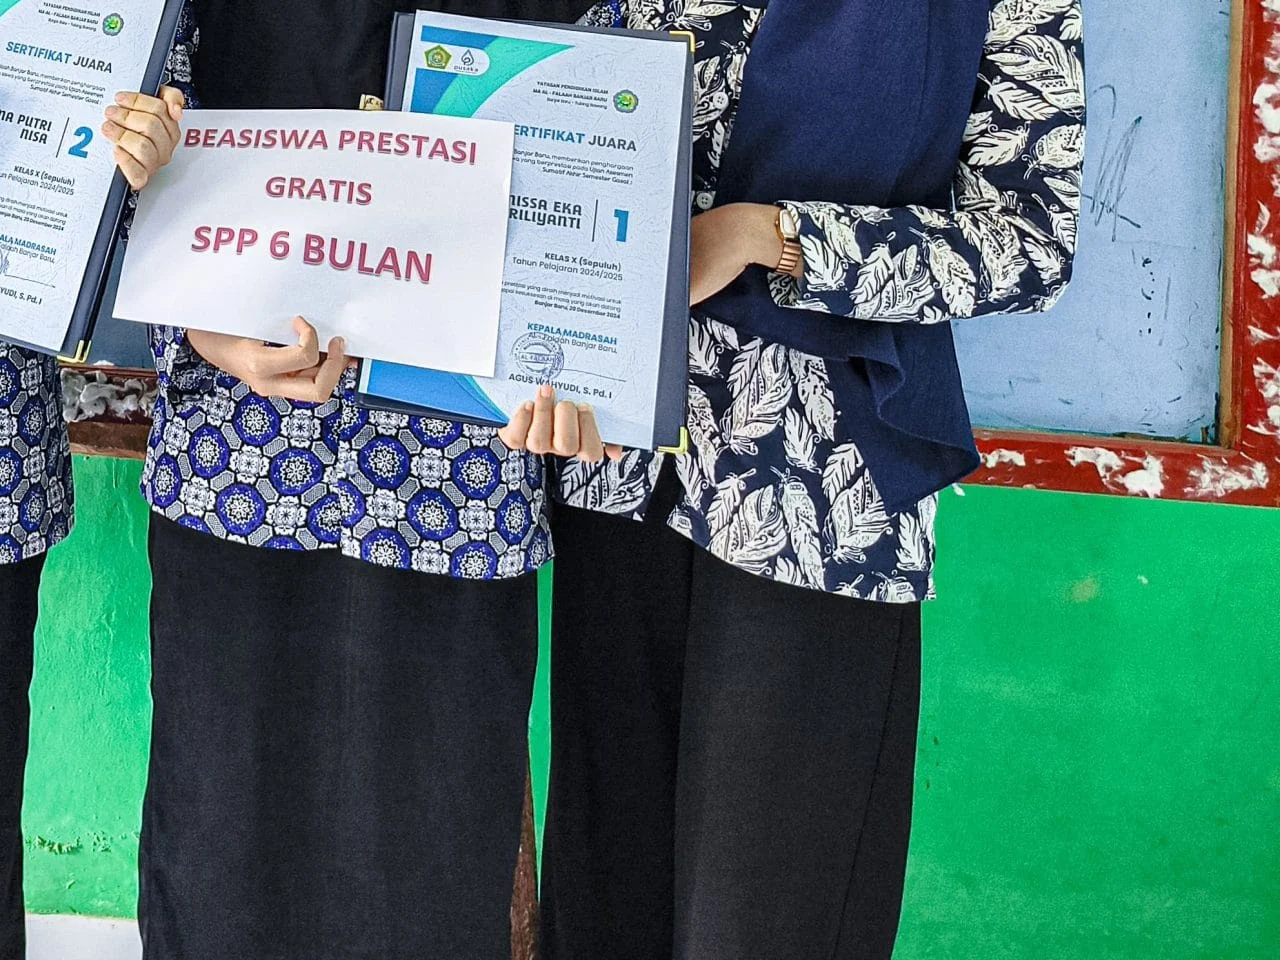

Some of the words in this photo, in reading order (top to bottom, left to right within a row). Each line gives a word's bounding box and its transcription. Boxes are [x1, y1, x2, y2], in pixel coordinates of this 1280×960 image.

[5, 41, 72, 64] SERTIFIKAT
[72, 55, 113, 73] JUARA
[16, 113, 52, 131] PUTRI
[19, 127, 48, 144] NISA
[68, 127, 94, 158] 2
[184, 128, 328, 150] BEASISWA
[338, 129, 477, 166] PRESTASI
[513, 123, 585, 144] ERTIFIKAT
[588, 134, 637, 151] JUARA
[7, 173, 39, 188] Pelajaran
[39, 180, 74, 196] 2024/2025
[13, 164, 34, 176] KELAS
[40, 170, 75, 188] (Sepuluh)
[265, 176, 372, 205] GRATIS
[508, 194, 547, 210] NISSA
[553, 201, 582, 216] EKA
[508, 207, 581, 231] RILIYANTI
[614, 209, 629, 242] 1
[14, 237, 56, 255] MADRASAH
[190, 226, 258, 255] SPP
[269, 230, 290, 259] 6
[302, 233, 433, 285] BULAN
[512, 256, 537, 267] Tahun
[538, 260, 578, 275] Pelajaran
[579, 266, 623, 282] 2024/2025
[544, 252, 569, 263] KELAS
[571, 256, 577, 264] X
[579, 256, 621, 272] (Sepuluh)
[18, 292, 26, 300] S.
[25, 294, 38, 304] Pd.
[527, 322, 562, 335] KEPALA
[562, 328, 617, 345] MADRASAH
[508, 372, 533, 384] AGUS
[535, 377, 581, 393] WAHYUDI,
[582, 386, 591, 395] S.
[593, 388, 606, 397] Pd.
[608, 391, 612, 399] I
